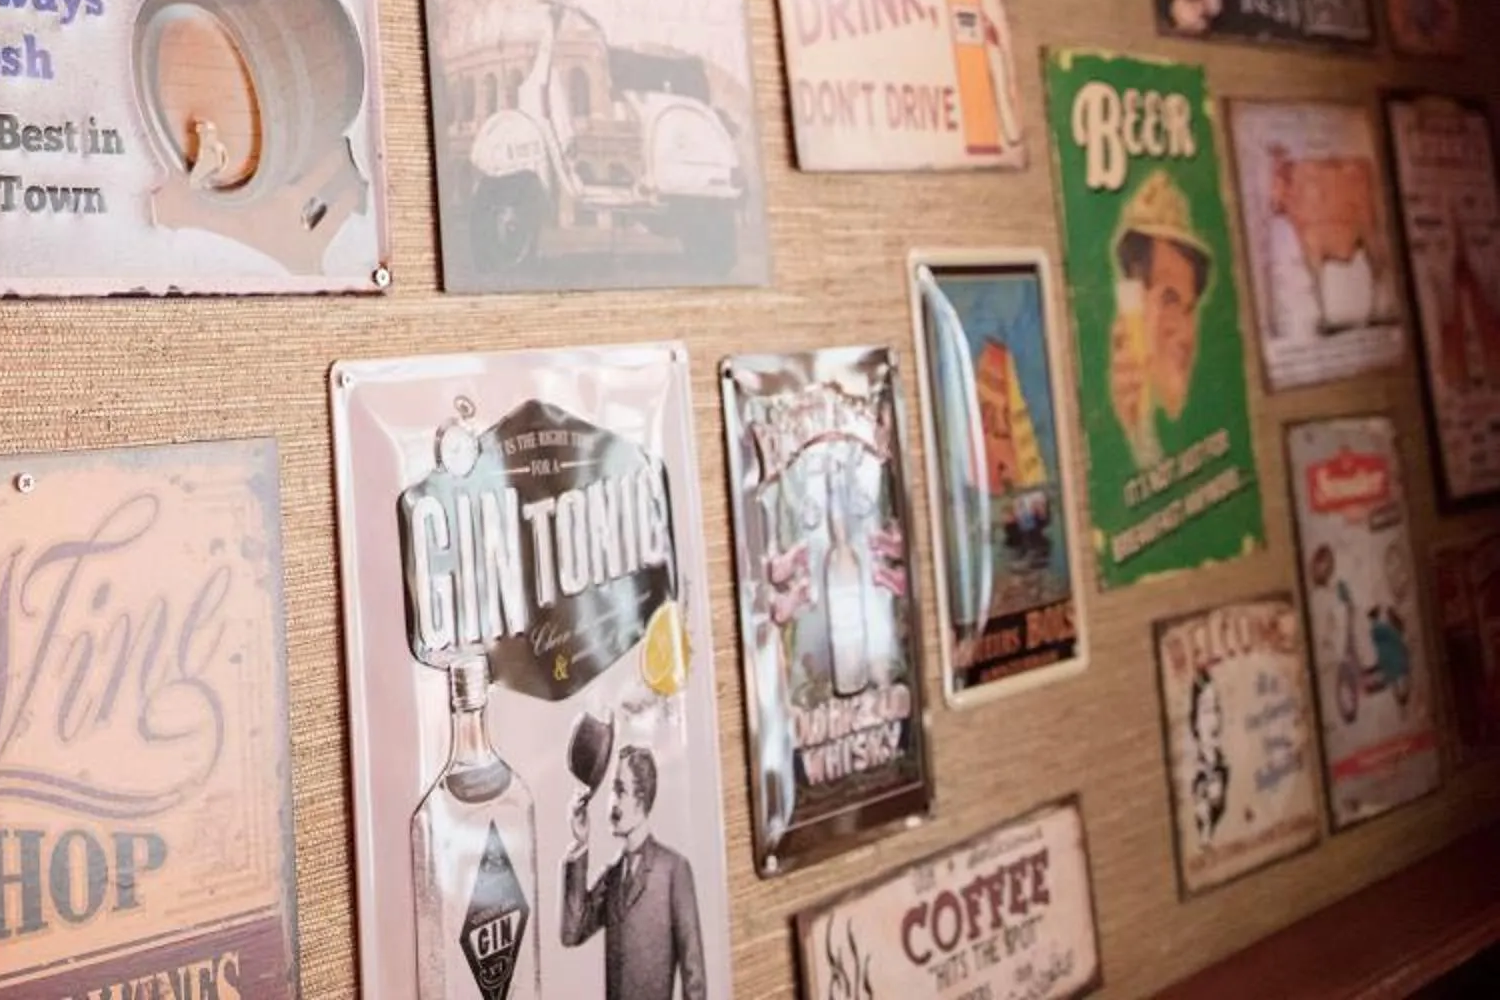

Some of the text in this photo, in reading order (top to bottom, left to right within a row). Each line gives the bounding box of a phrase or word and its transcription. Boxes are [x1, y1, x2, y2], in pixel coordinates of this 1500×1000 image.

[88, 114, 125, 157] in
[884, 83, 959, 132] DRIVE
[1071, 80, 1196, 190] BEER
[410, 484, 528, 653] GIN
[475, 915, 515, 958] GIN
[901, 846, 1051, 968] COFFEE
